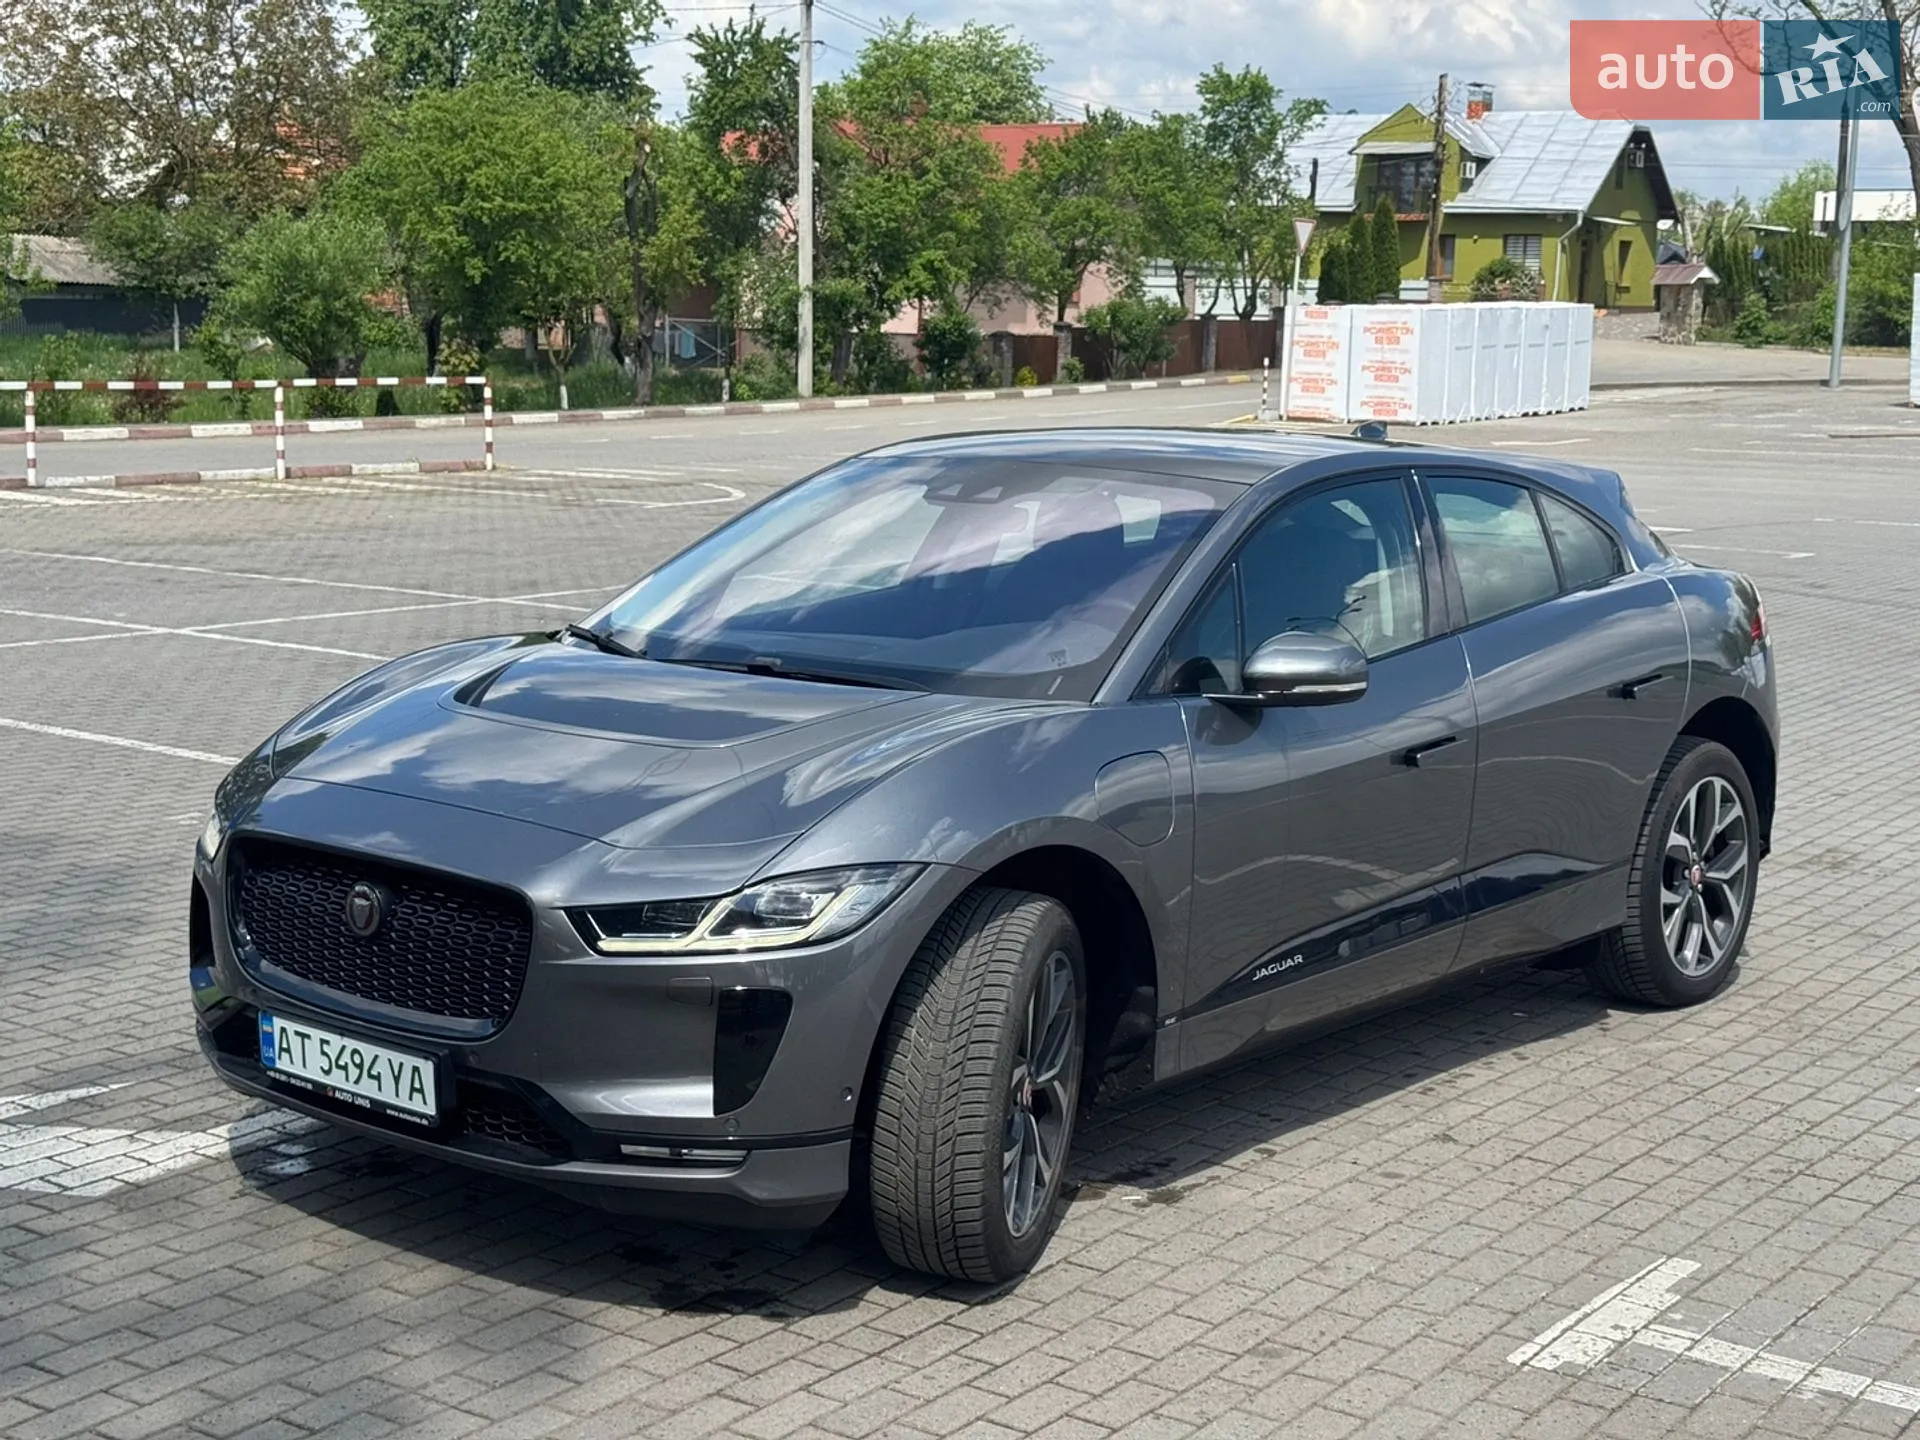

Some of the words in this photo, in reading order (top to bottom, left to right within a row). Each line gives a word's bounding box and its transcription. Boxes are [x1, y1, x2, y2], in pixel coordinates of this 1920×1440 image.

[1252, 954, 1304, 981] JAGUAR
[262, 1046, 274, 1058] UA
[278, 1025, 312, 1069] AT
[319, 1037, 382, 1093] 5494
[387, 1057, 428, 1106] YA
[334, 1089, 353, 1103] AUTO
